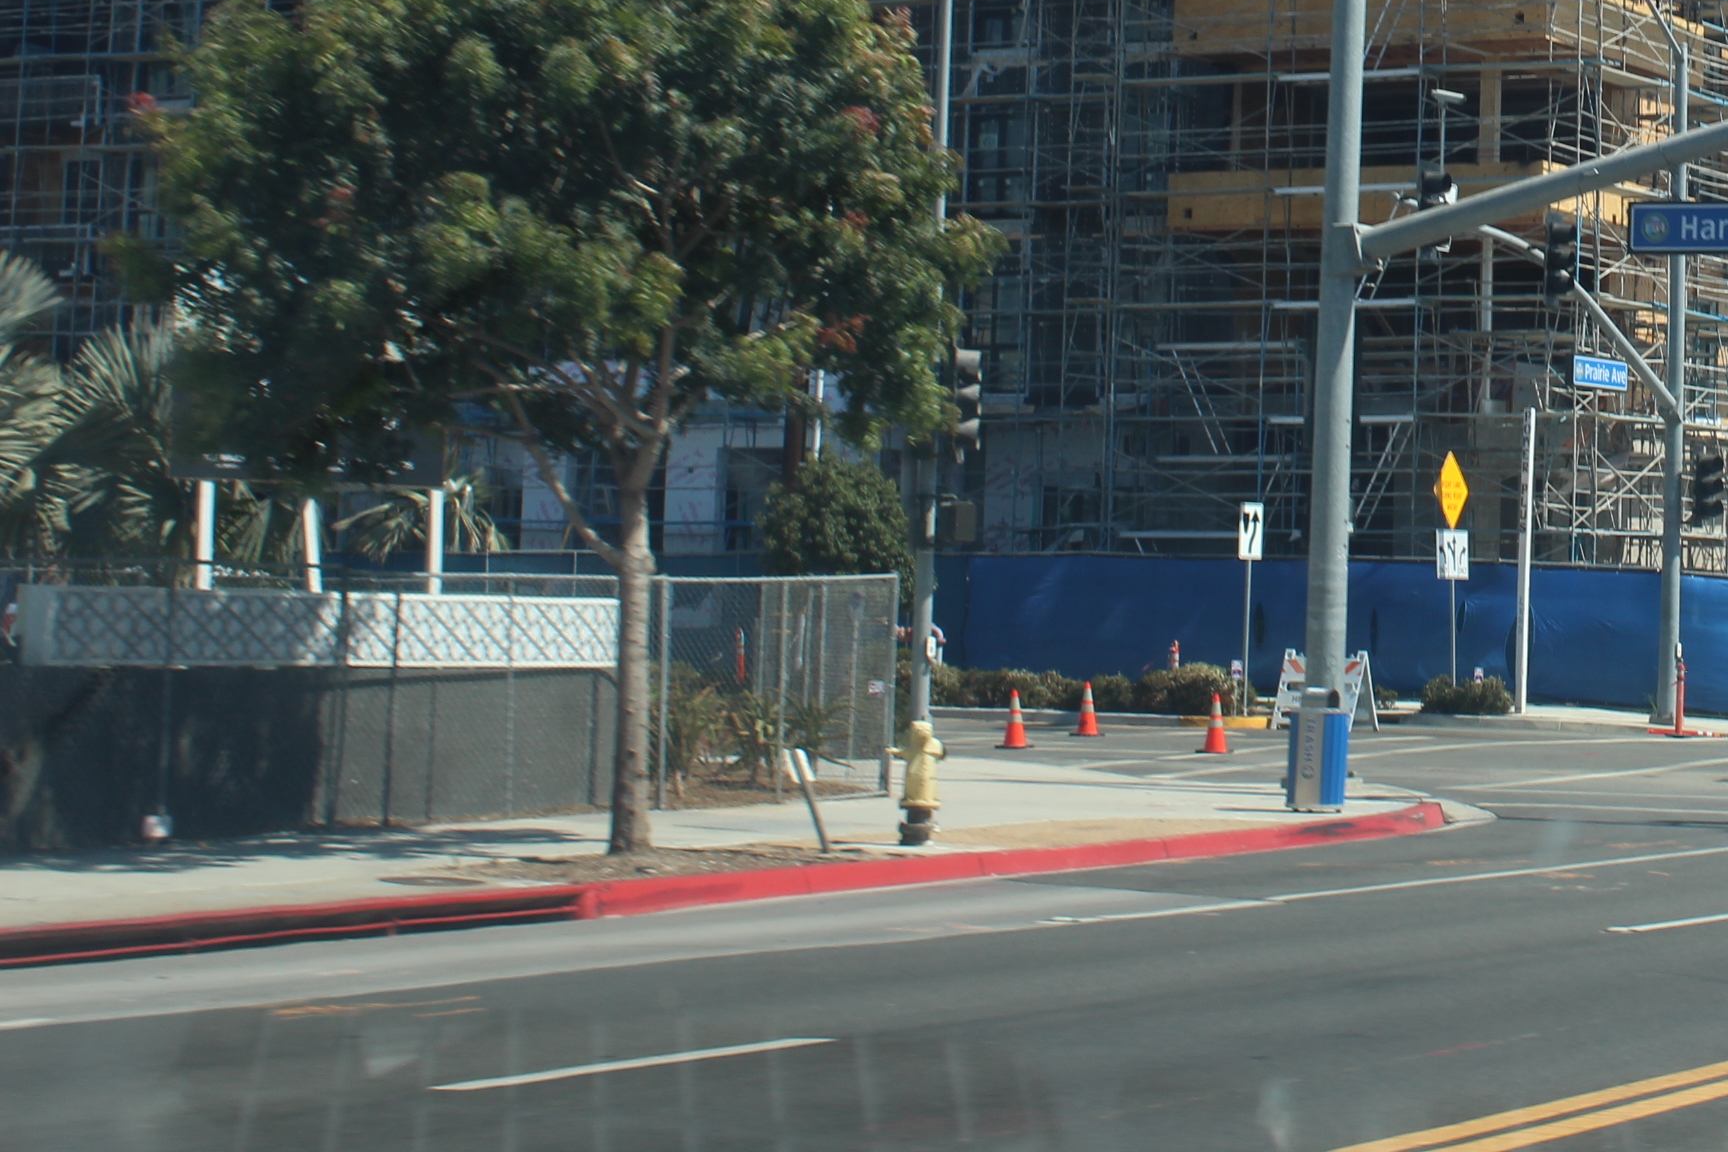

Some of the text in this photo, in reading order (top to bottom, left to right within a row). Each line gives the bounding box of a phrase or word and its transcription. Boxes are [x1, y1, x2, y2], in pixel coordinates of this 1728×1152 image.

[1584, 363, 1627, 385] Prairie Ave
[1519, 483, 1529, 532] PLUS
[1303, 718, 1317, 763] TRASH
